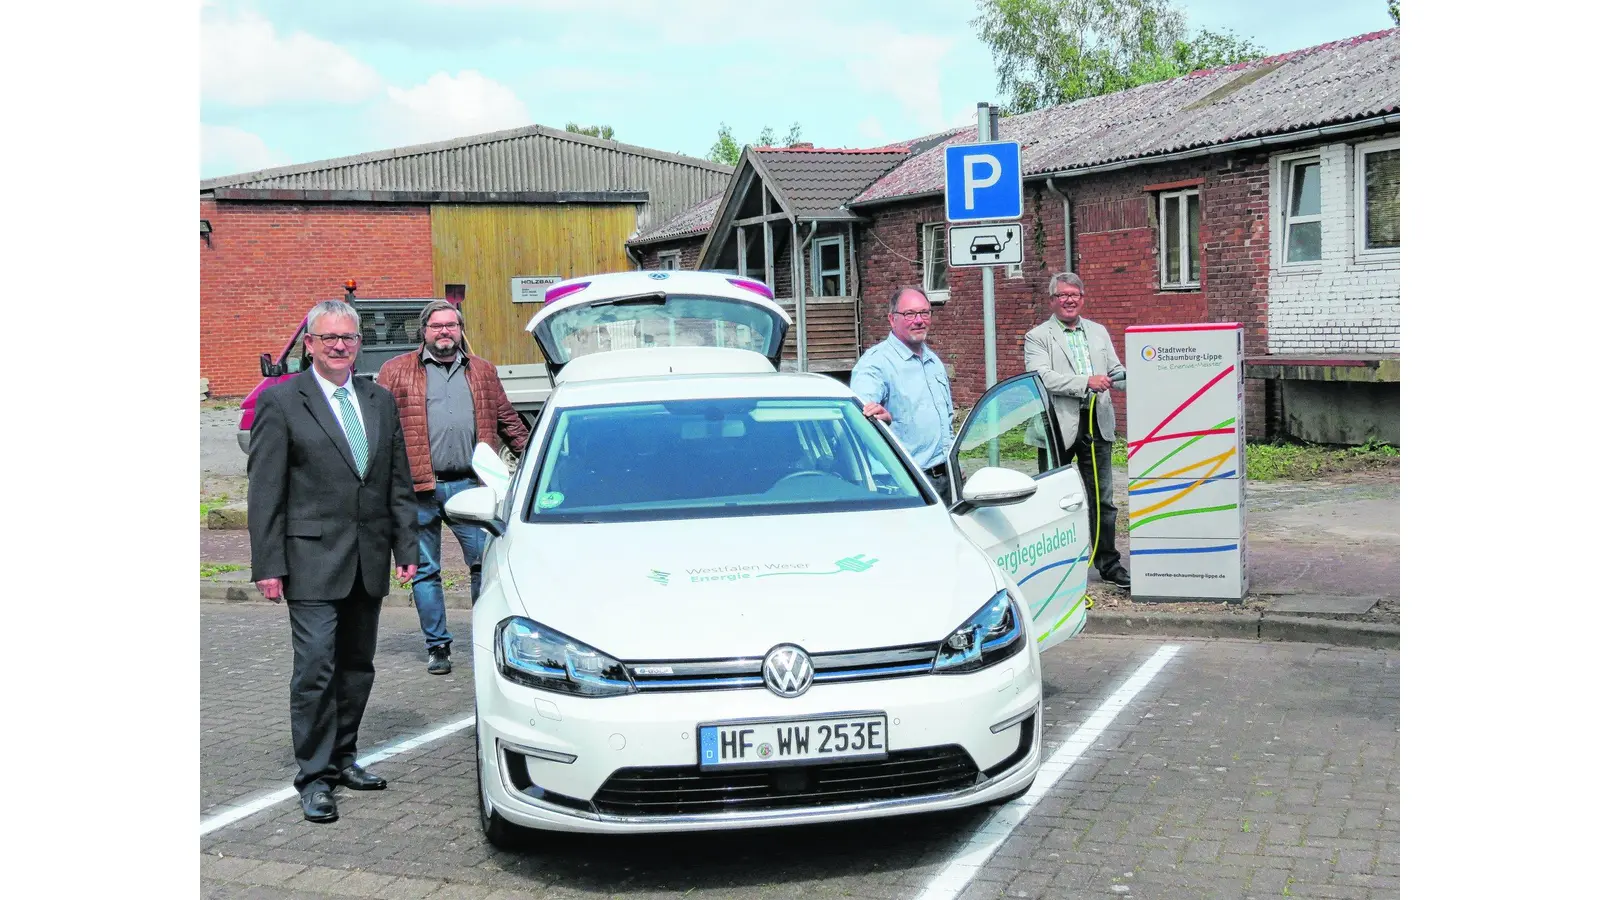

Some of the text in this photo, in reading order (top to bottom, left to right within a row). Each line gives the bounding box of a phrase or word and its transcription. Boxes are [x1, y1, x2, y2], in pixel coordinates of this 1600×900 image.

[963, 154, 1002, 210] P
[1157, 346, 1197, 354] Stadtwerke
[1157, 353, 1223, 362] Schaumburg-Lippe
[995, 522, 1077, 574] ergiegeladen!
[686, 562, 811, 575] Westfalen Weser
[691, 573, 751, 583] Energie
[721, 721, 883, 759] HF WW 253E
[706, 750, 713, 758] D
